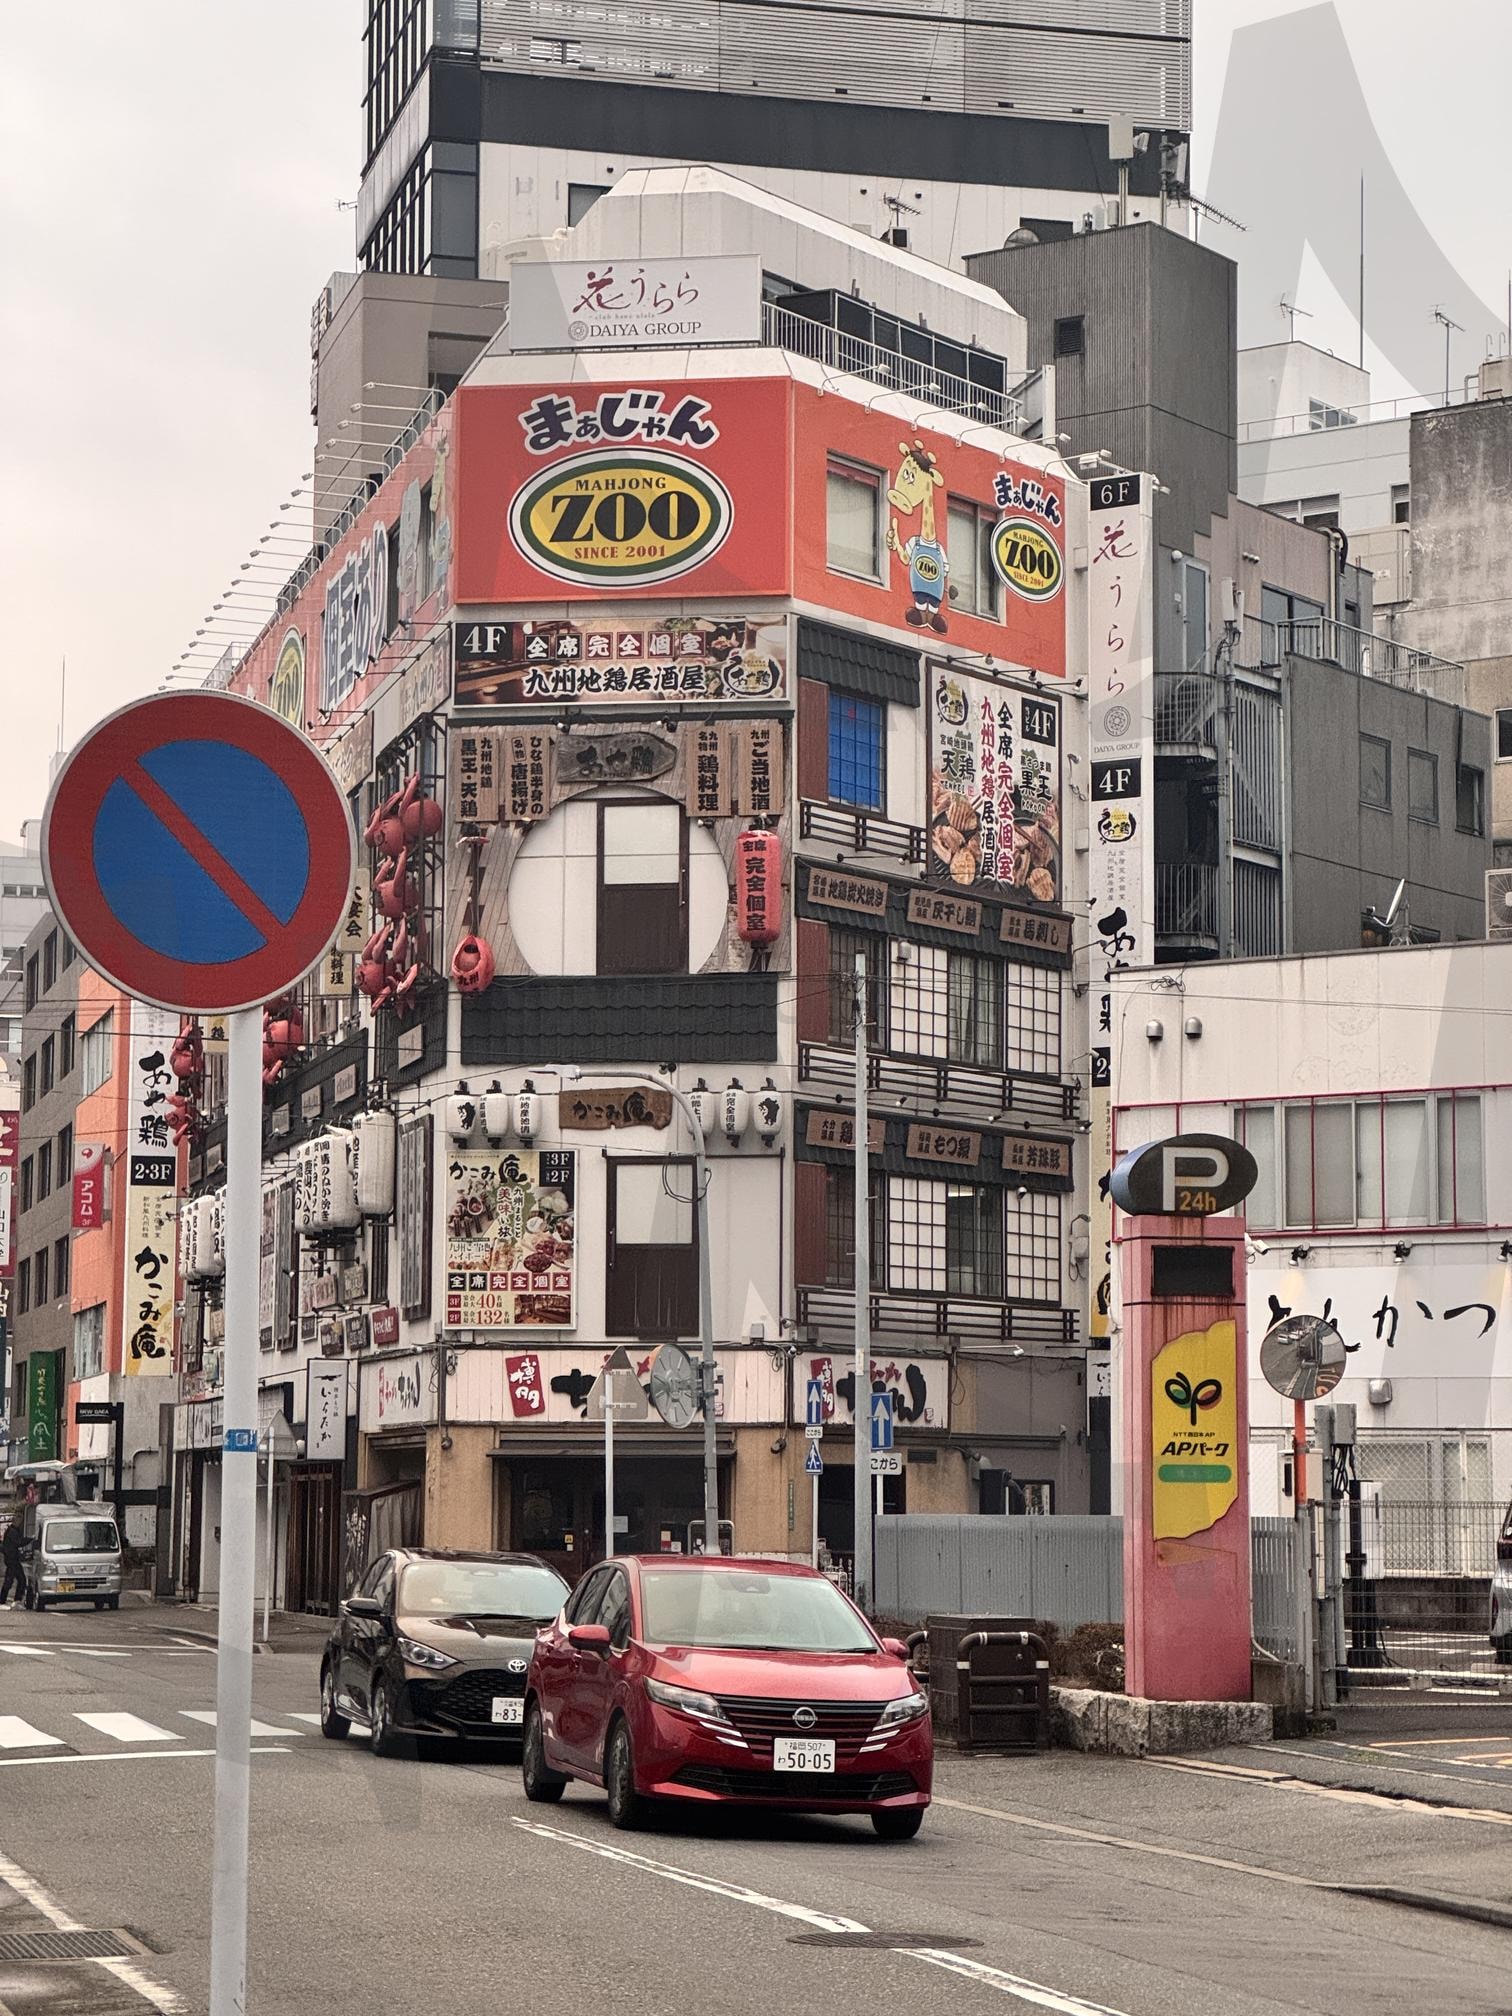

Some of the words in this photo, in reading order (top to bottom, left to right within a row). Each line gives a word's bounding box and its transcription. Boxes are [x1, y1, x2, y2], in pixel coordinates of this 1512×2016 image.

[573, 267, 698, 314] 花うらら
[590, 324, 639, 337] DAIYA
[645, 322, 701, 335] GROUP
[575, 477, 667, 491] MAHJONG
[1101, 482, 1130, 504] 6F
[549, 491, 701, 543] ZOO
[574, 546, 618, 559] SINCE
[625, 545, 666, 558] 2001
[1005, 538, 1054, 579] ZOO
[918, 561, 937, 575] ZOO
[1093, 520, 1138, 697] 花うらら
[463, 626, 506, 653] 4F
[527, 634, 703, 658] 全席完全個室
[525, 665, 705, 694] 九州地鶏居酒屋
[750, 730, 770, 739] 九州
[1031, 708, 1053, 738] 4F
[709, 731, 718, 751] 九州
[530, 737, 543, 814] ひな鶏半身の
[751, 740, 770, 810] ご当地酒
[940, 750, 976, 783] 天鶏
[511, 764, 528, 815] 唐揚げ
[698, 755, 719, 811] 鶏料理
[980, 696, 996, 878] 九州地鶏居酒屋
[997, 701, 1014, 883] 全席完全個室
[1019, 766, 1052, 802] 黒王
[1099, 767, 1131, 794] 4F
[746, 857, 766, 931] 完全個室
[551, 1153, 570, 1165] 3F
[933, 1135, 971, 1160] もつ鍋
[449, 1154, 528, 1183] かこみ庵
[551, 1170, 570, 1182] 2F
[1163, 1147, 1229, 1211] P
[81, 1180, 94, 1216] アコム
[1180, 1191, 1216, 1211] 24h
[513, 1187, 523, 1238] 九州まるごと
[450, 1275, 568, 1288] 全席完全個室
[132, 1246, 169, 1359] かこみ庵
[477, 1294, 495, 1308] 40
[477, 1311, 502, 1324] 132
[510, 1358, 540, 1410] 博多
[1161, 1441, 1229, 1456] APパーク
[870, 1457, 898, 1470] こから
[503, 1708, 522, 1720] 83-
[807, 1742, 822, 1751] 507
[788, 1752, 831, 1769] 50-05
